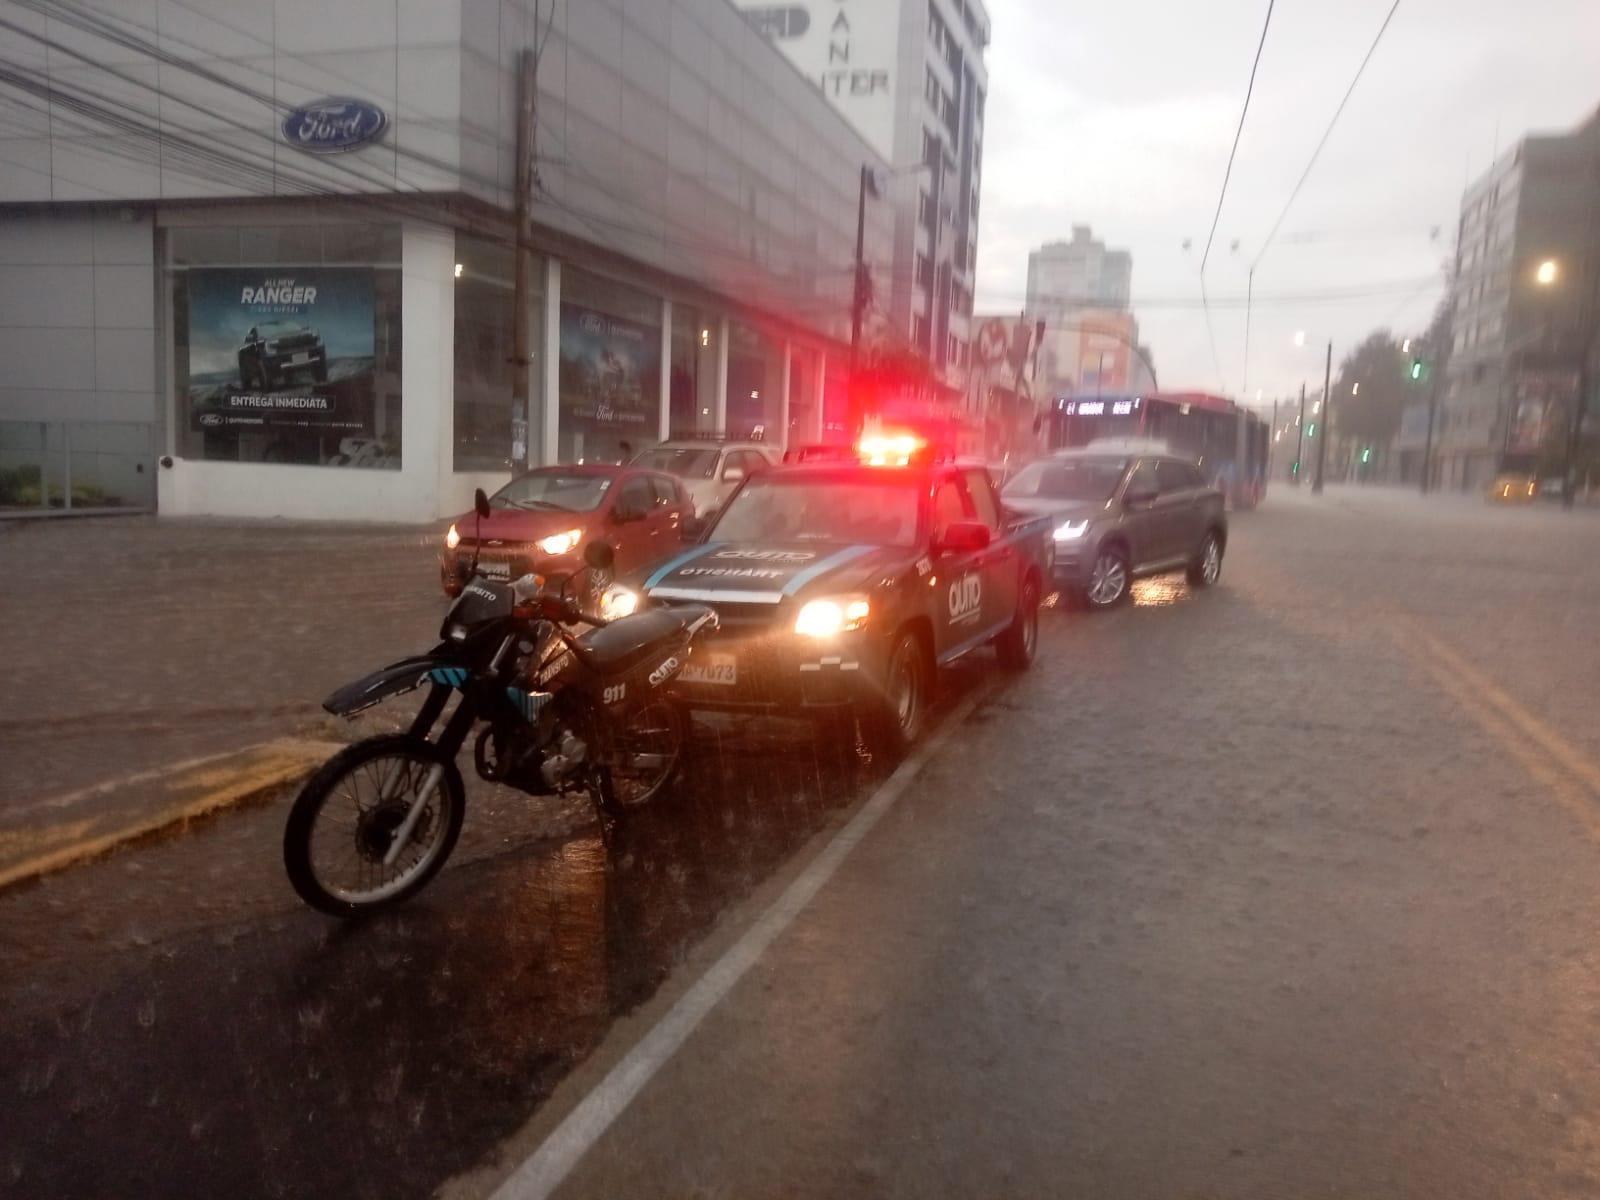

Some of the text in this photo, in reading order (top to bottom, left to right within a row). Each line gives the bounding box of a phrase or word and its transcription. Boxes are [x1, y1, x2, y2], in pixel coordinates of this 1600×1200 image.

[299, 105, 362, 140] Ford
[241, 287, 317, 304] RANGER
[231, 396, 328, 409] ENTREGA INMEDIATA
[711, 550, 817, 561] QUITO
[949, 574, 981, 617] QUITO
[648, 656, 679, 686] QUITO
[603, 684, 626, 704] 911
